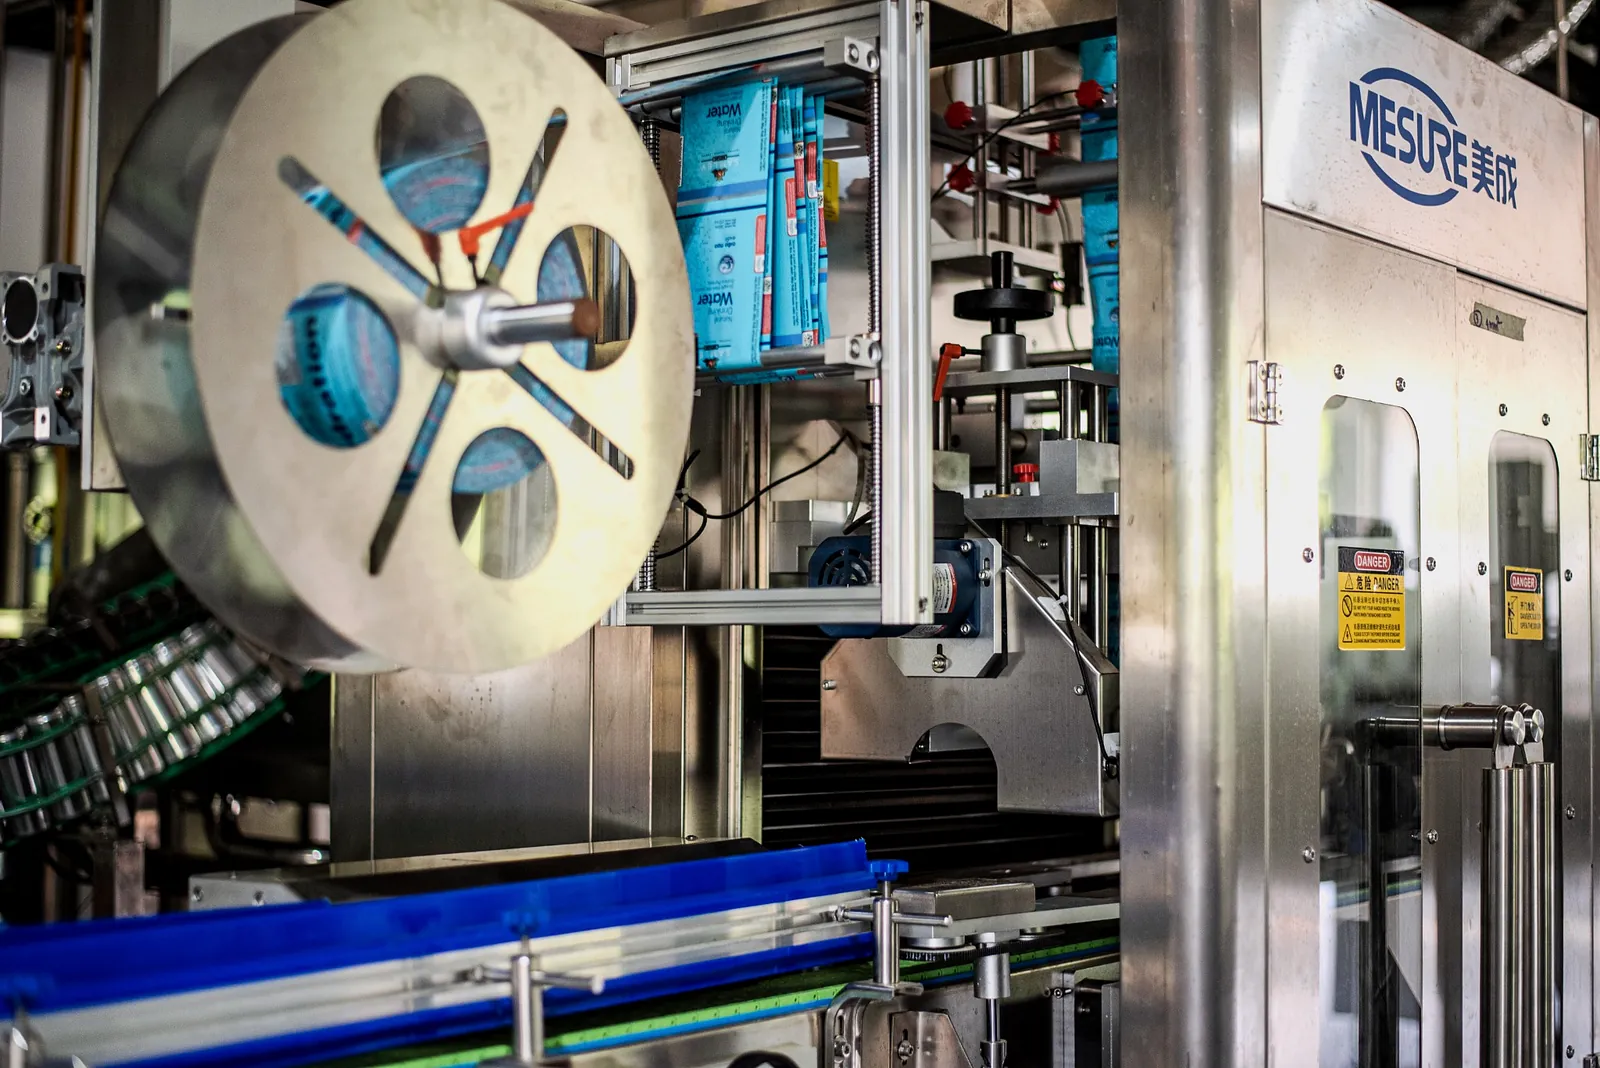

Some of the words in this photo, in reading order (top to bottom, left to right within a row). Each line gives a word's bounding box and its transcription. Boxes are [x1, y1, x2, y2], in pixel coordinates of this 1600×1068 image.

[706, 102, 742, 118] Water
[1349, 80, 1468, 189] MESURE
[1471, 138, 1518, 210] 美成
[697, 291, 734, 307] Water
[1357, 555, 1388, 569] DANGER
[1356, 575, 1372, 590] 危险
[1373, 576, 1400, 591] DANGER
[1512, 575, 1535, 589] DANGER
